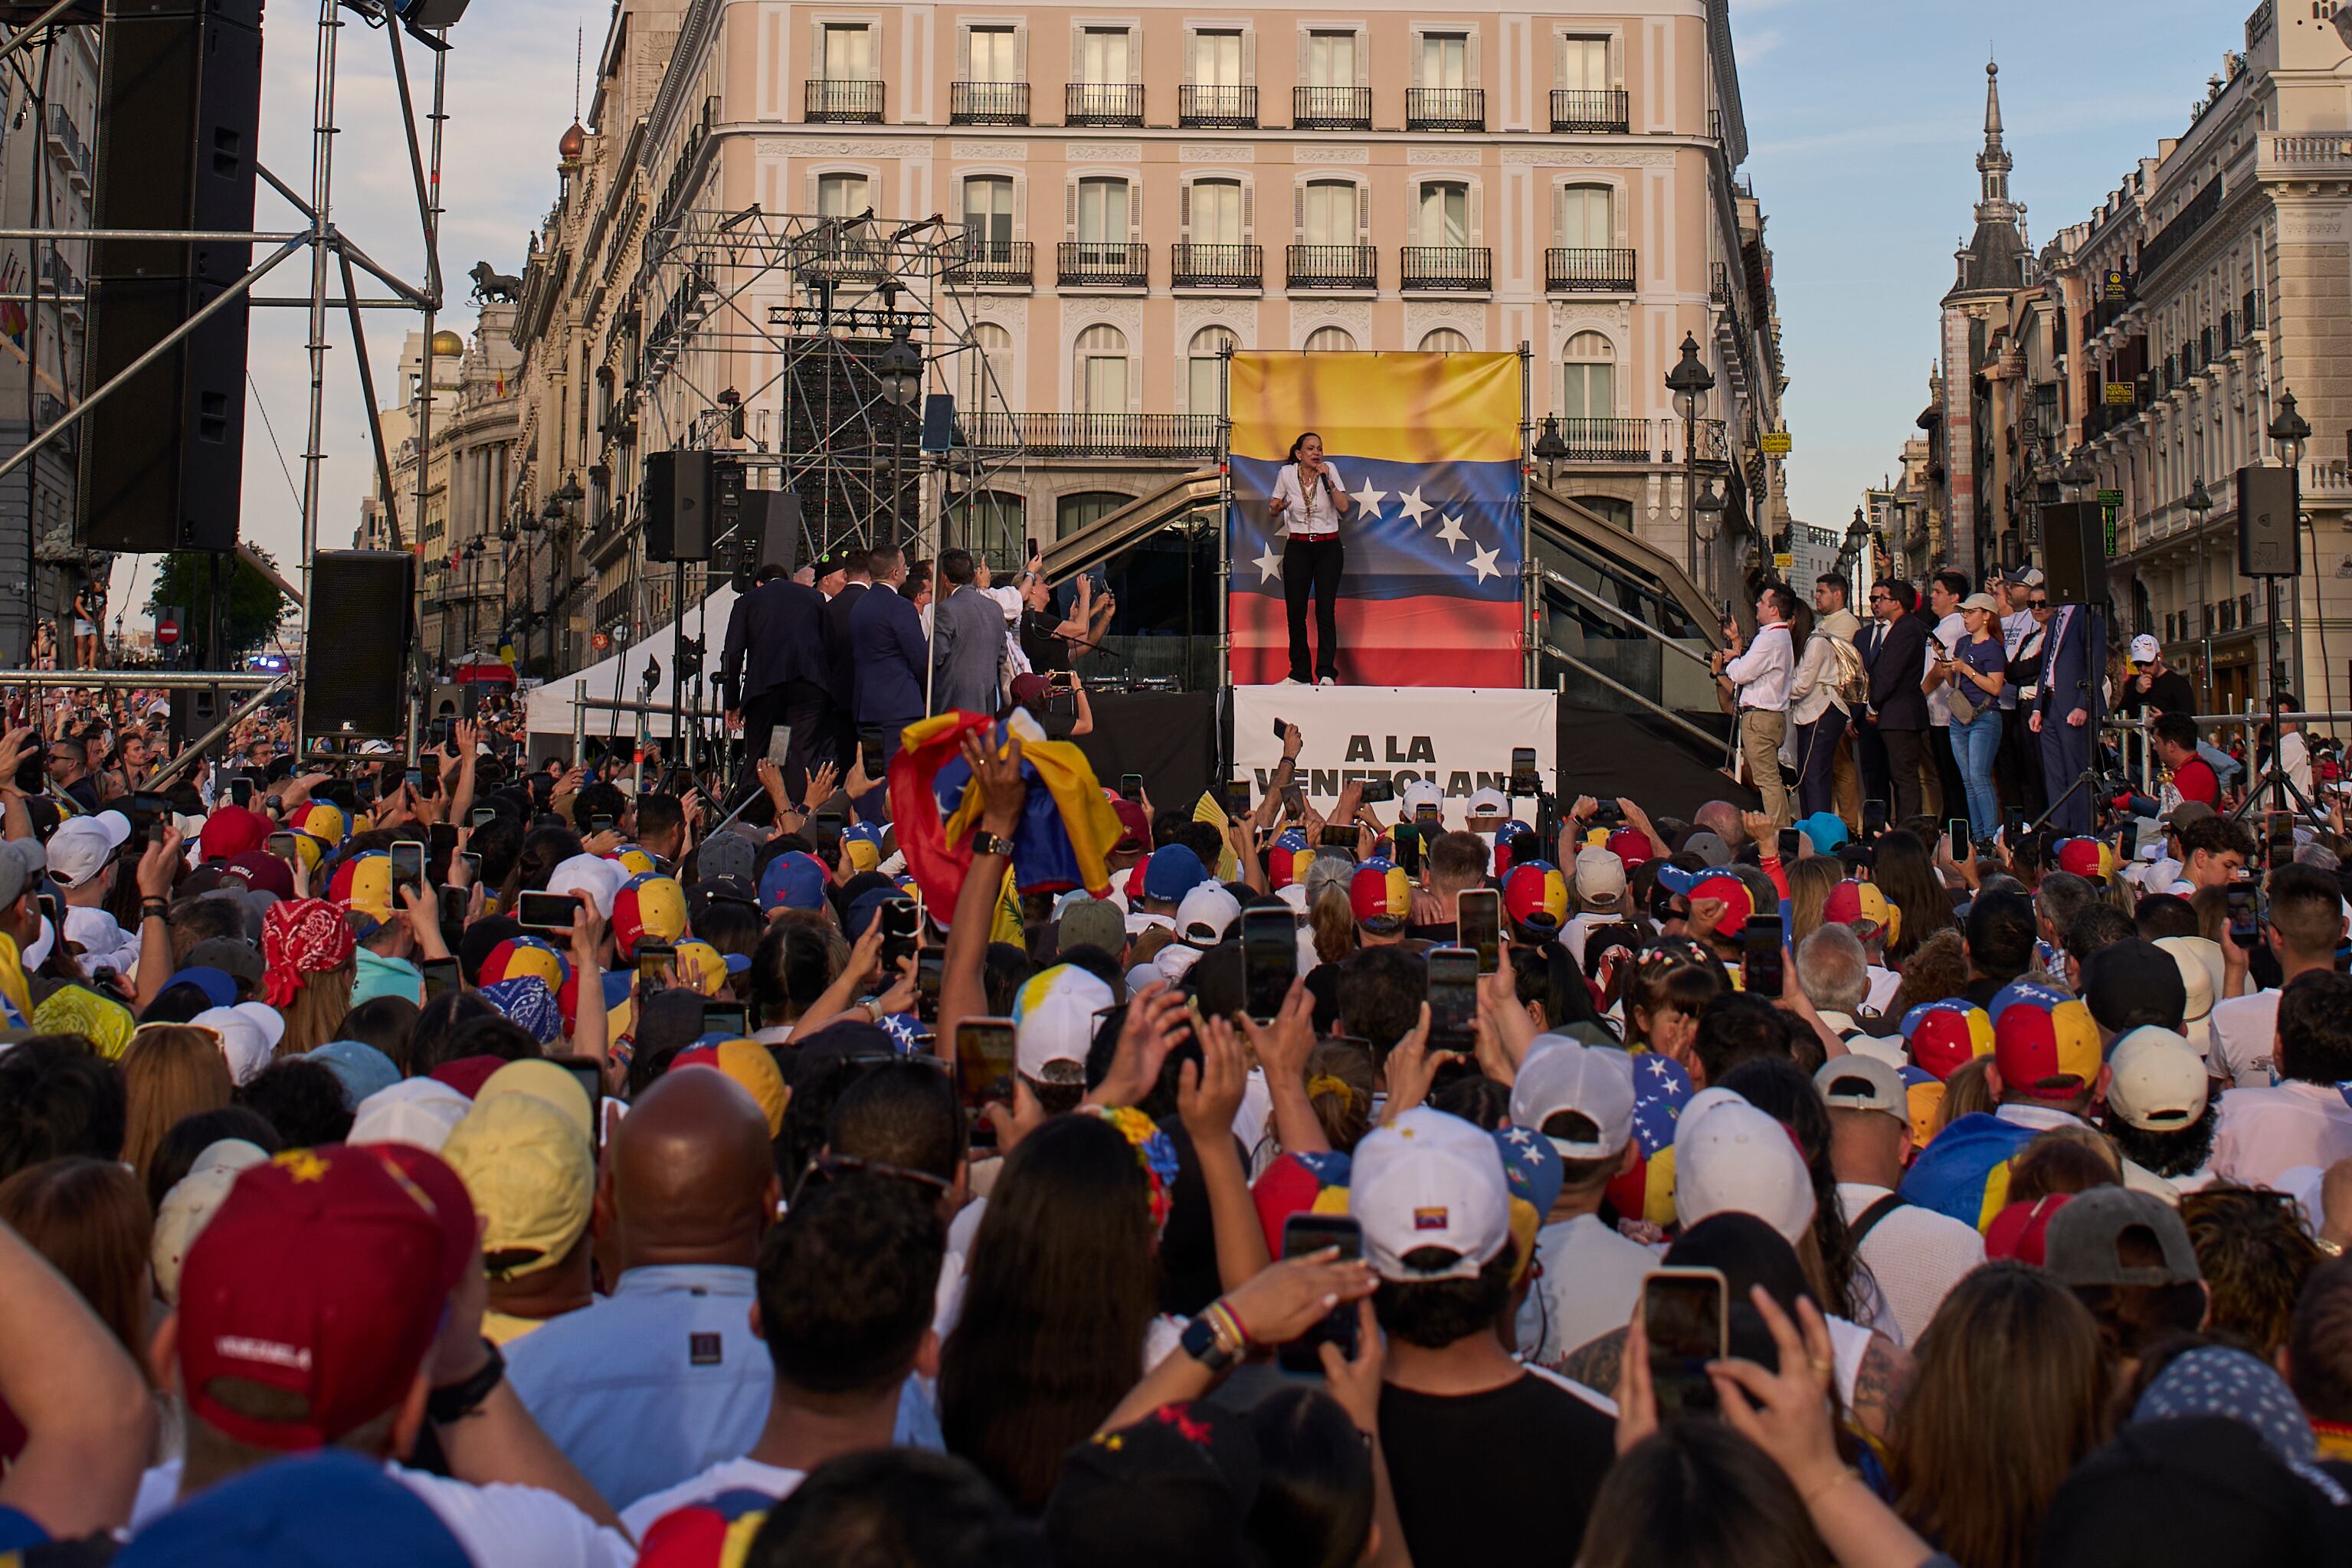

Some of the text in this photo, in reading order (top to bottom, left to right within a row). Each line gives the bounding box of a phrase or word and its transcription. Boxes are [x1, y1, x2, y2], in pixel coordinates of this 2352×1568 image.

[1345, 735, 1436, 764] A LA
[1254, 768, 1535, 798] VENOAN
[230, 865, 254, 880] VENEZUELA
[627, 921, 663, 935] VENEZUELA
